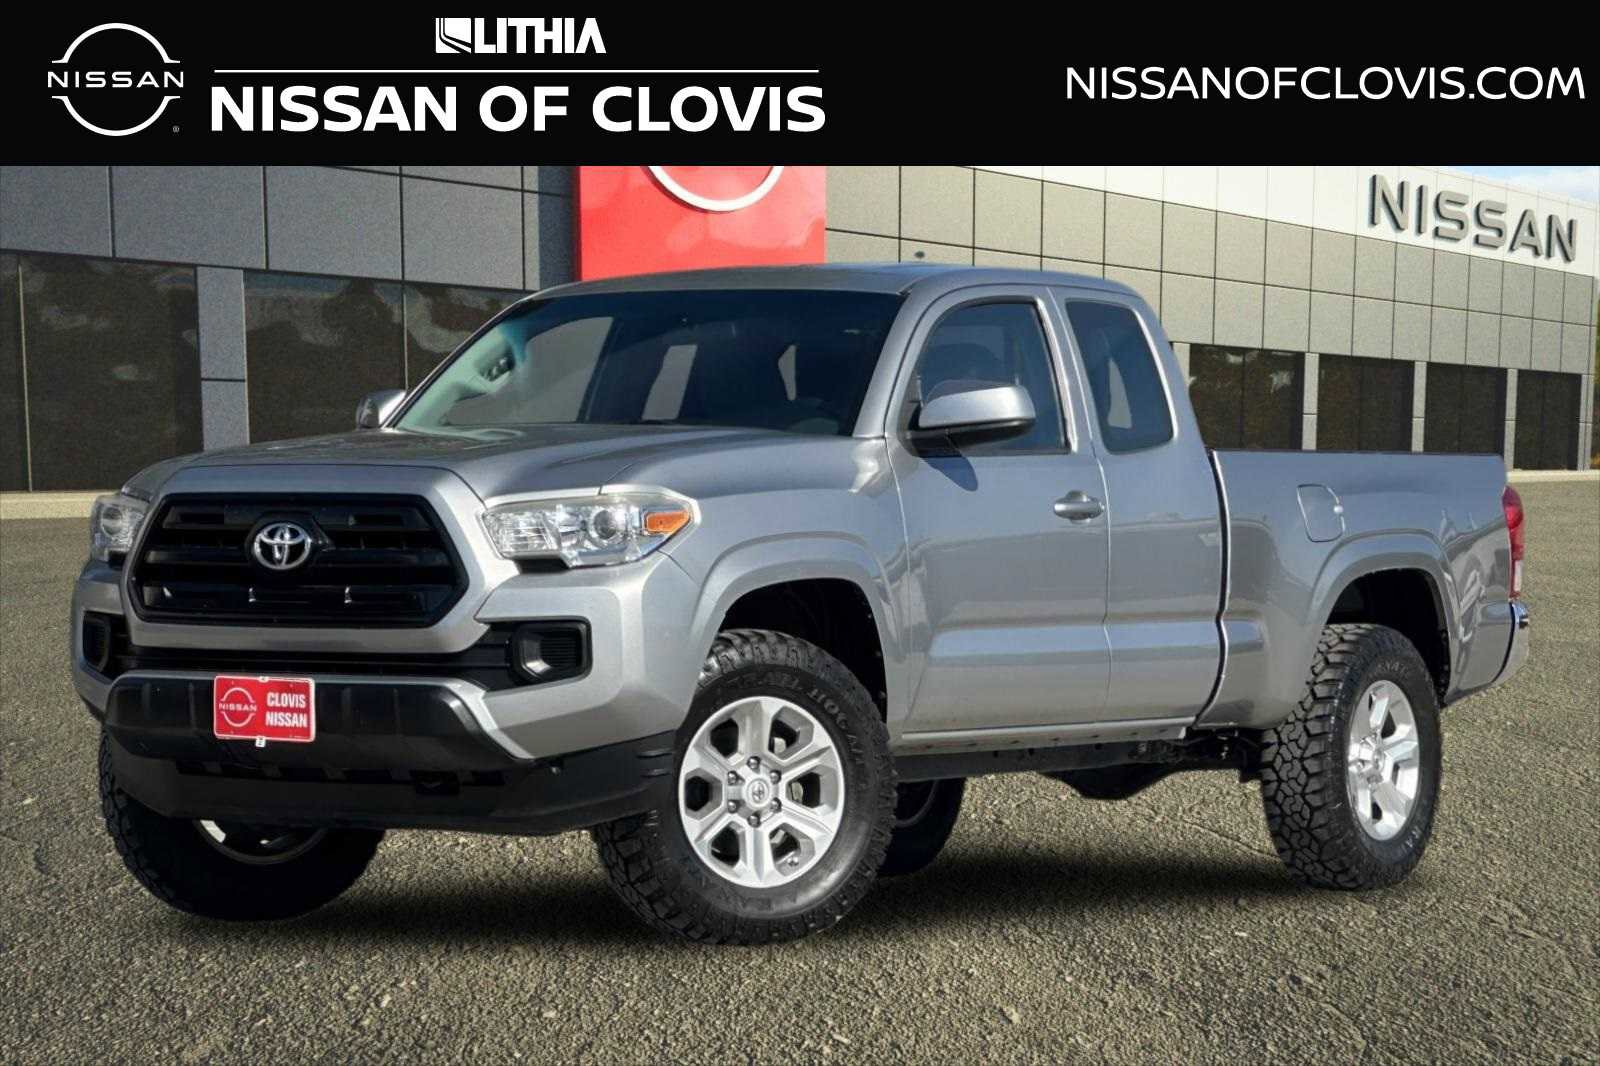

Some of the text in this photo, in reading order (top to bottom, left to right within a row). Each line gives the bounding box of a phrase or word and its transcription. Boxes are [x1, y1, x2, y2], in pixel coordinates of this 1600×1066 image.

[1369, 174, 1578, 263] NISSAN
[218, 703, 258, 712] NISSAN
[266, 692, 306, 709] CLOVIS
[265, 711, 308, 728] NISSAN
